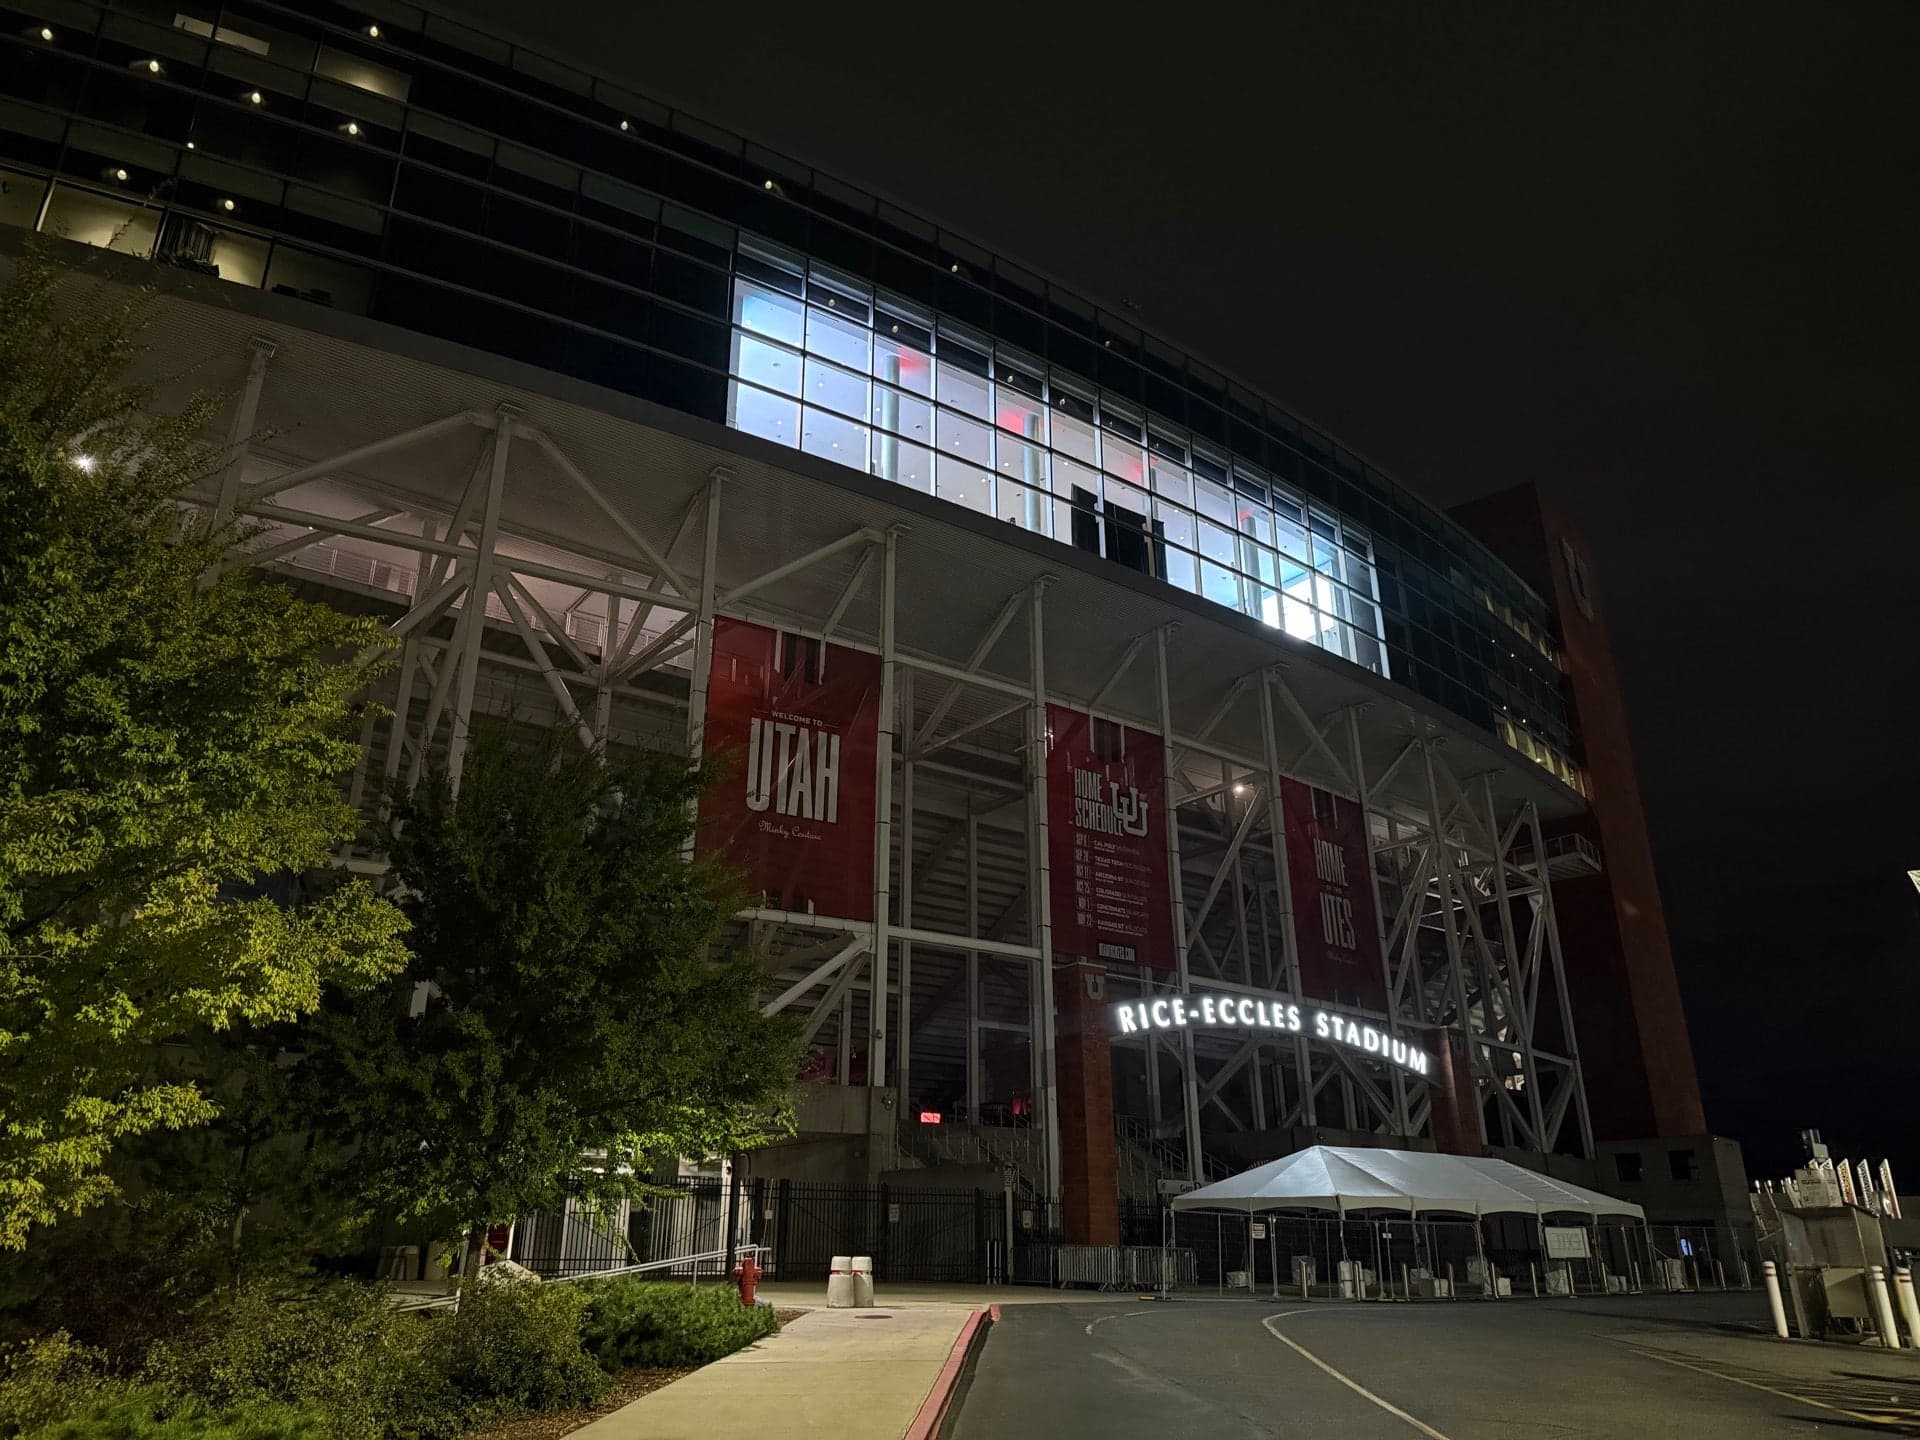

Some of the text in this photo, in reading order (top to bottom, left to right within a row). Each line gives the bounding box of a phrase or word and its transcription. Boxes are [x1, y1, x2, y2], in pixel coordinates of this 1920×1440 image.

[771, 710, 823, 727] WELCOME TO
[746, 717, 841, 824] UTAH
[1074, 767, 1103, 802] HOME
[1075, 797, 1125, 837] SCHEDULE
[1314, 837, 1348, 888] HOME
[1320, 891, 1357, 951] UTES
[1118, 997, 1428, 1075] RICE-ECCLES STADIUM
